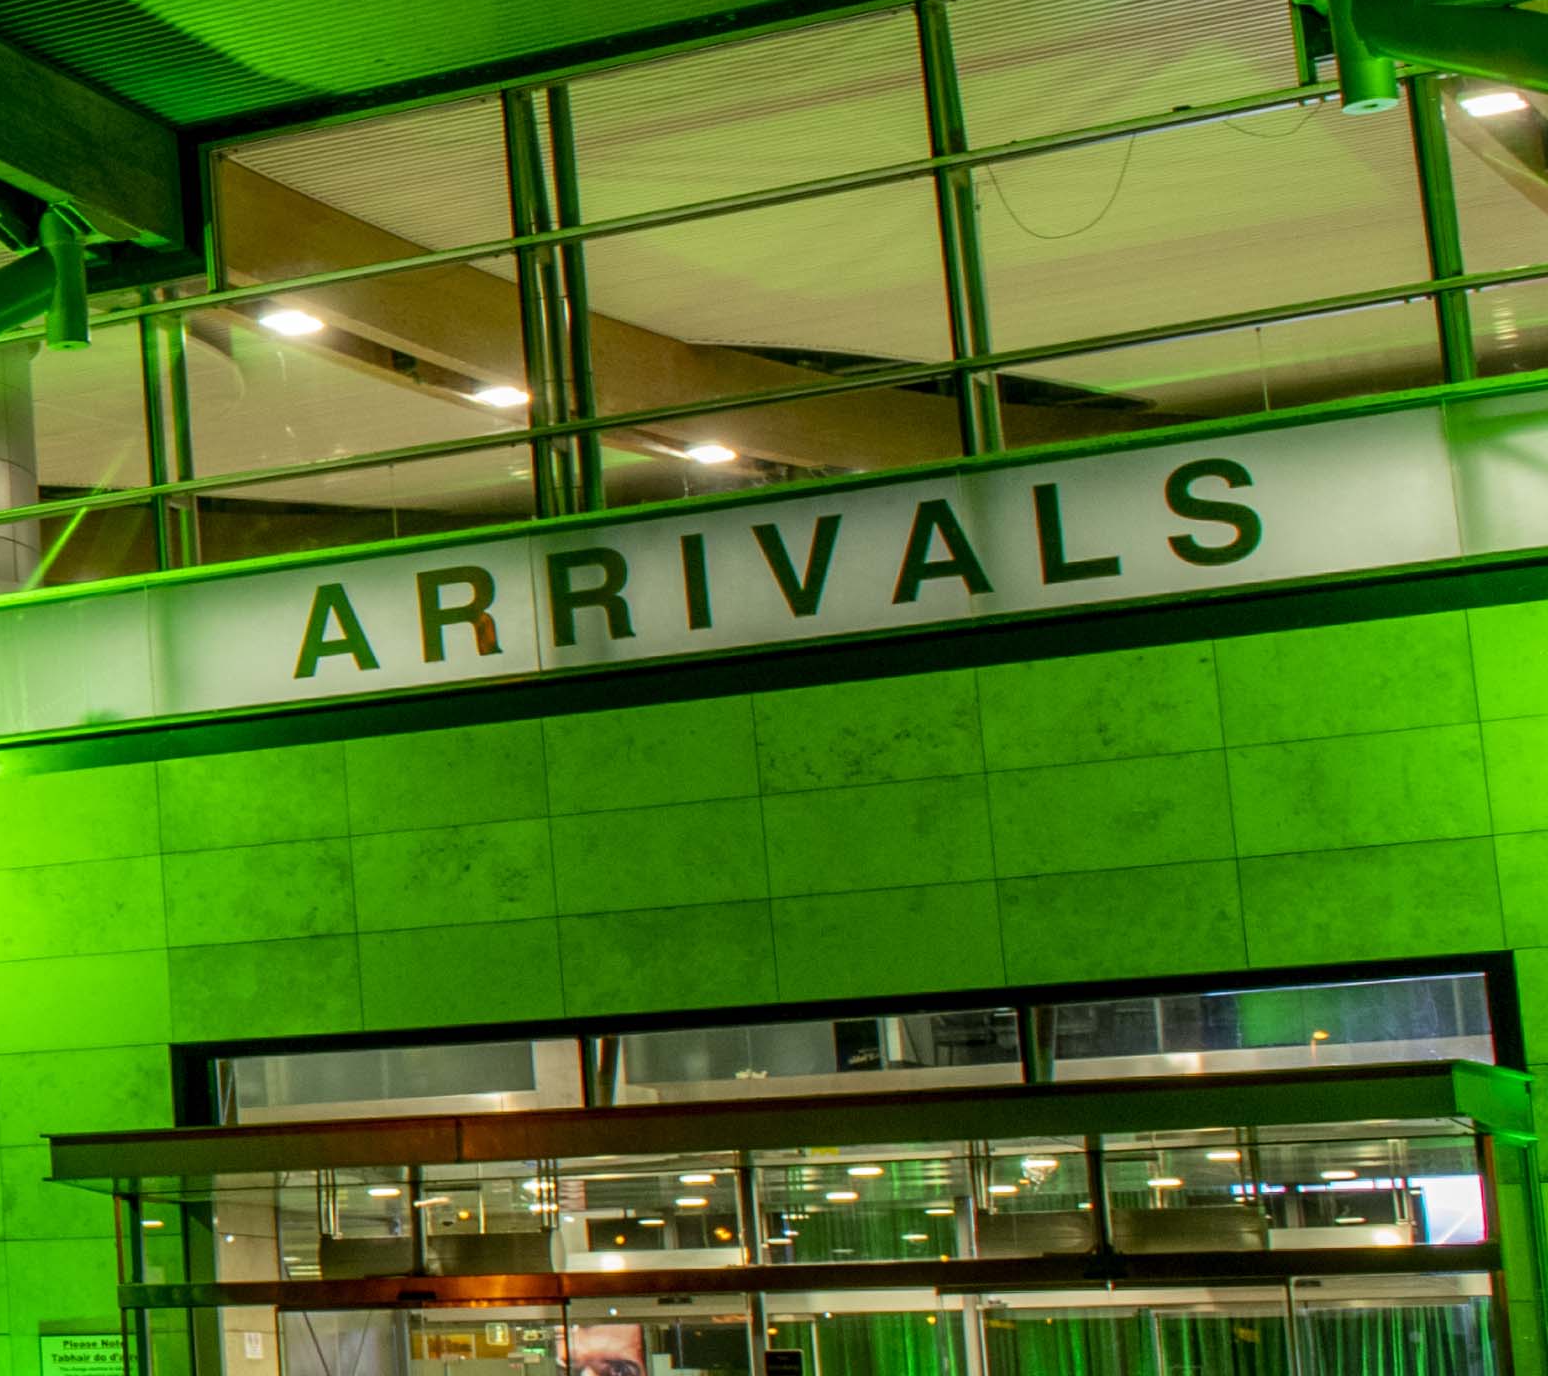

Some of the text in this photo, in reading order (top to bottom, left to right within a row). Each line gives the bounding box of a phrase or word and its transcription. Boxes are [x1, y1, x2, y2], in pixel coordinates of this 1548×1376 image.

[294, 457, 1264, 680] ARRIVALS
[63, 1340, 97, 1348] Please
[94, 1353, 107, 1362] do
